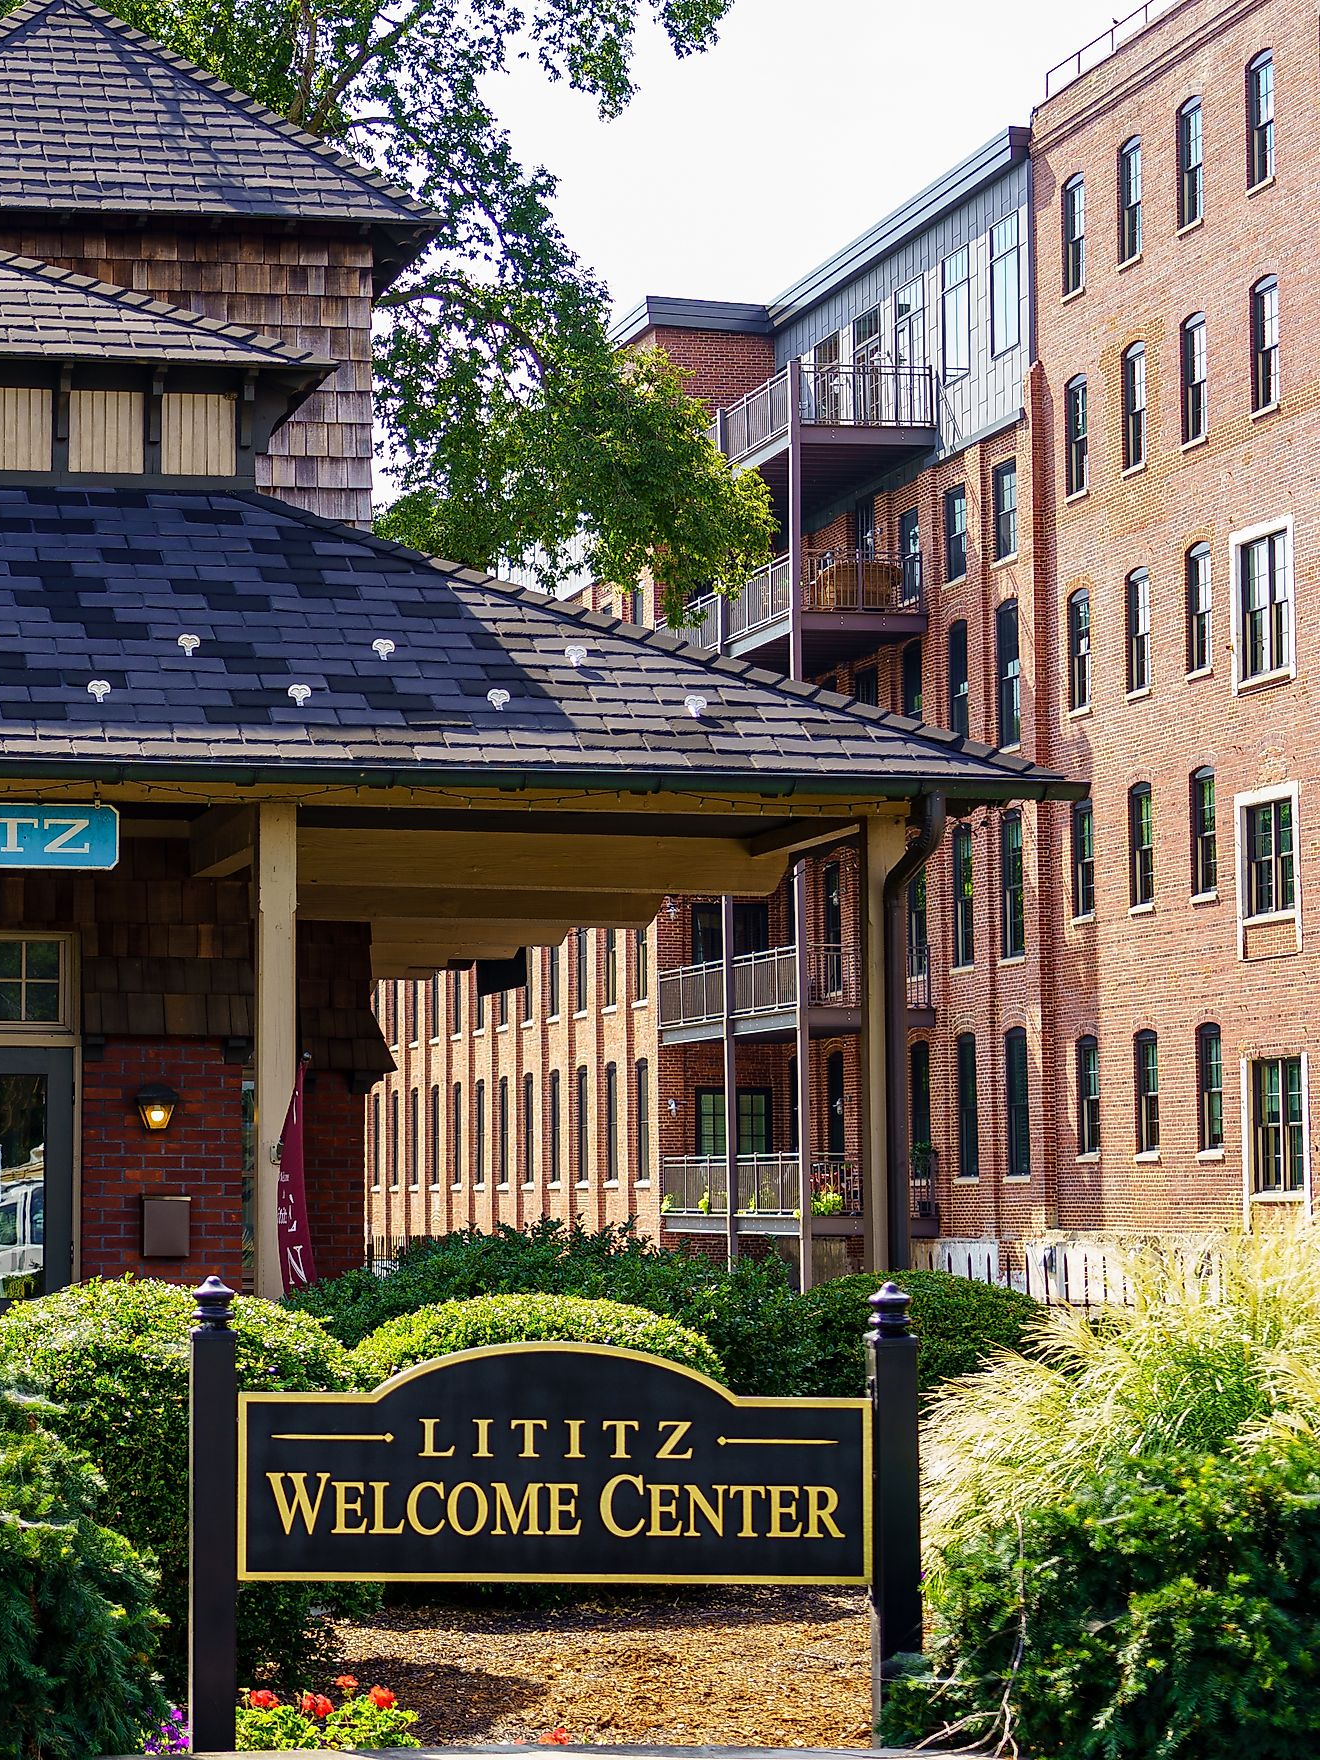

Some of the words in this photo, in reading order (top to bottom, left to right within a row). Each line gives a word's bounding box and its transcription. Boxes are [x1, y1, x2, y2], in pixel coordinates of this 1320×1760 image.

[417, 1417, 694, 1461] LITITZ
[265, 1471, 583, 1537] WELCOME
[599, 1473, 846, 1539] CENTER
